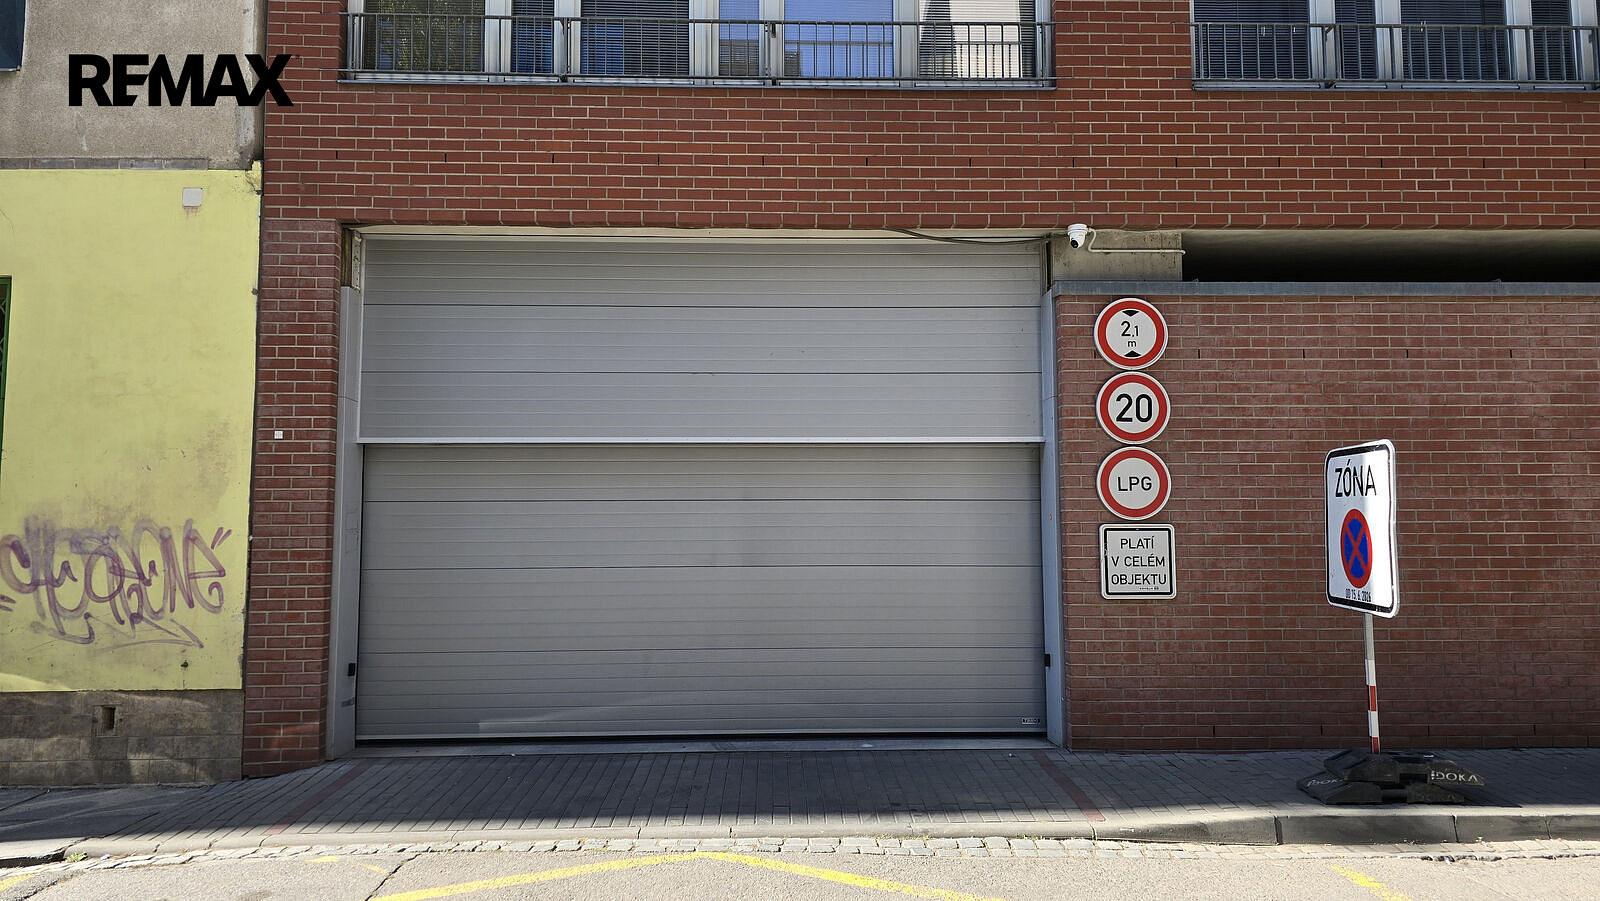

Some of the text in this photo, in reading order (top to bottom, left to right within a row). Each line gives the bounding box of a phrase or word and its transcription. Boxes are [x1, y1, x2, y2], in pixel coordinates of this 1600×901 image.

[1120, 320, 1139, 338] 2,1
[1127, 340, 1137, 348] m
[1115, 393, 1153, 422] 20
[1117, 476, 1152, 491] LPG
[1335, 459, 1377, 498] ZÓNA
[1120, 536, 1155, 549] PLATÍ
[1111, 553, 1165, 567] V CELÉM
[1111, 574, 1167, 585] OBJEKTU
